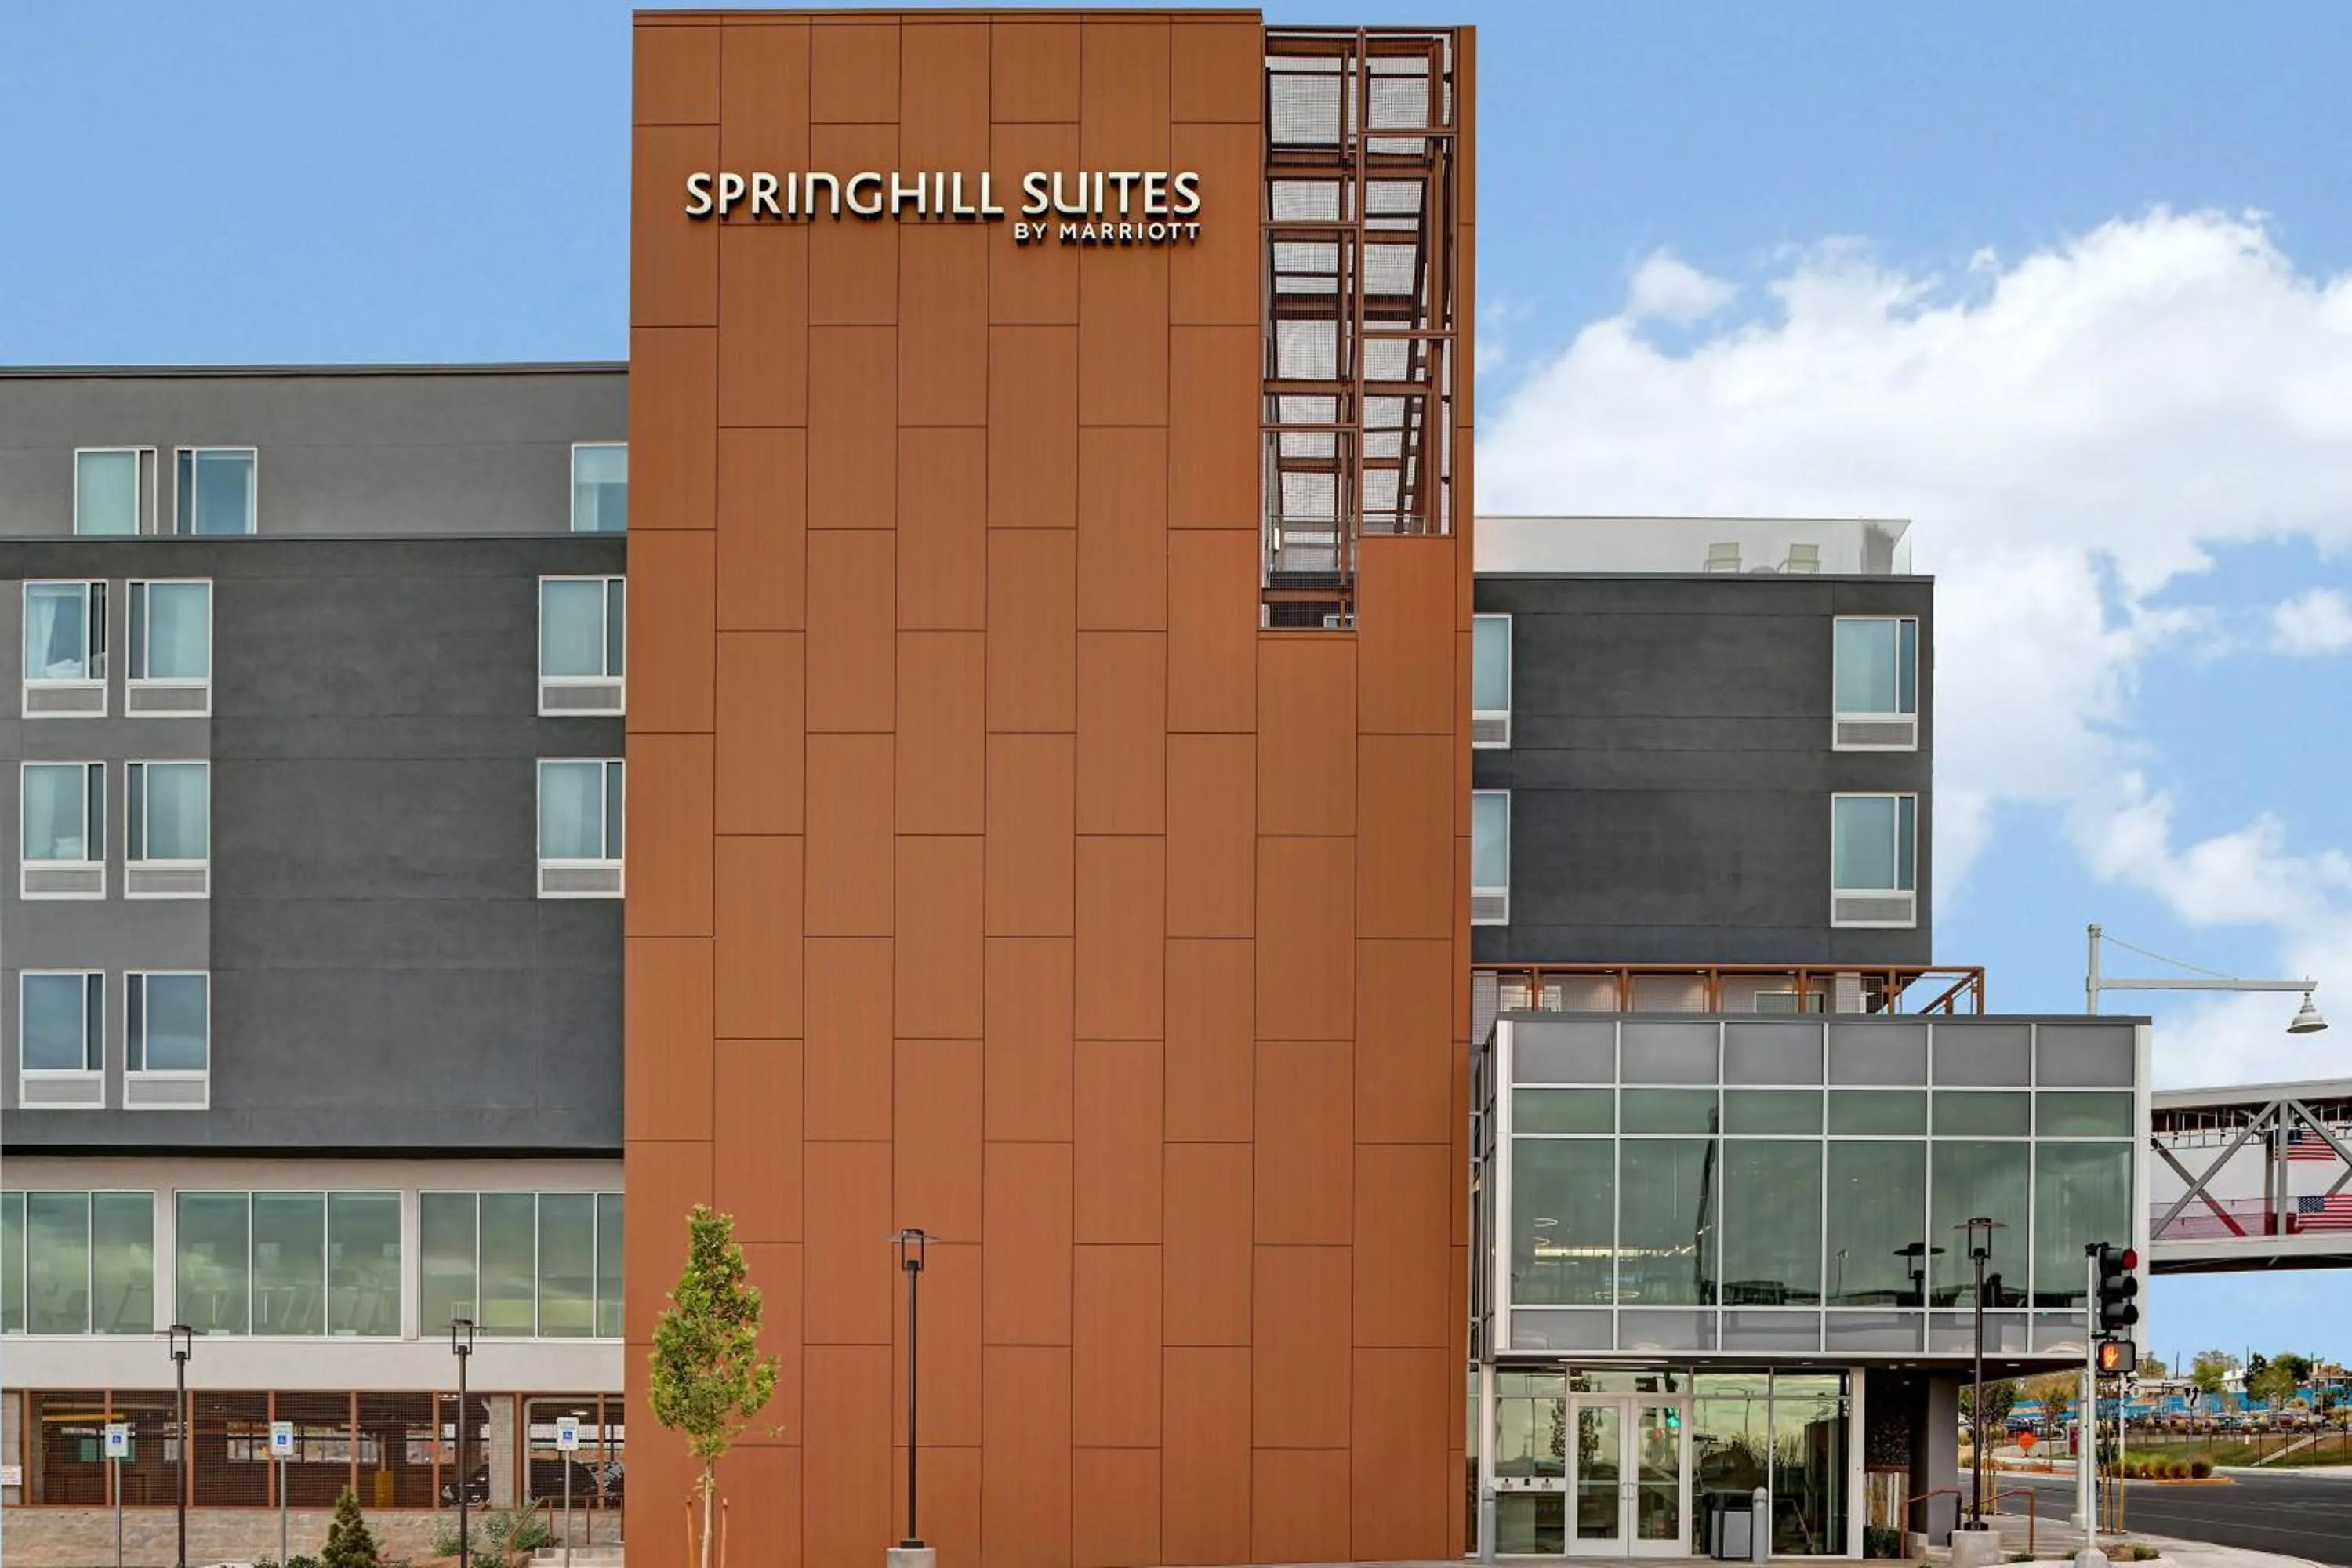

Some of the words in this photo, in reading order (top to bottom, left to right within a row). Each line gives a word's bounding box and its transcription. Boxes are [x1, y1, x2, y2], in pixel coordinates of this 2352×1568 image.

[684, 172, 1004, 216] SPRINGHILL
[1022, 171, 1201, 215] SUITES
[1014, 222, 1047, 240] BY
[1059, 222, 1200, 241] MARRIOTT
